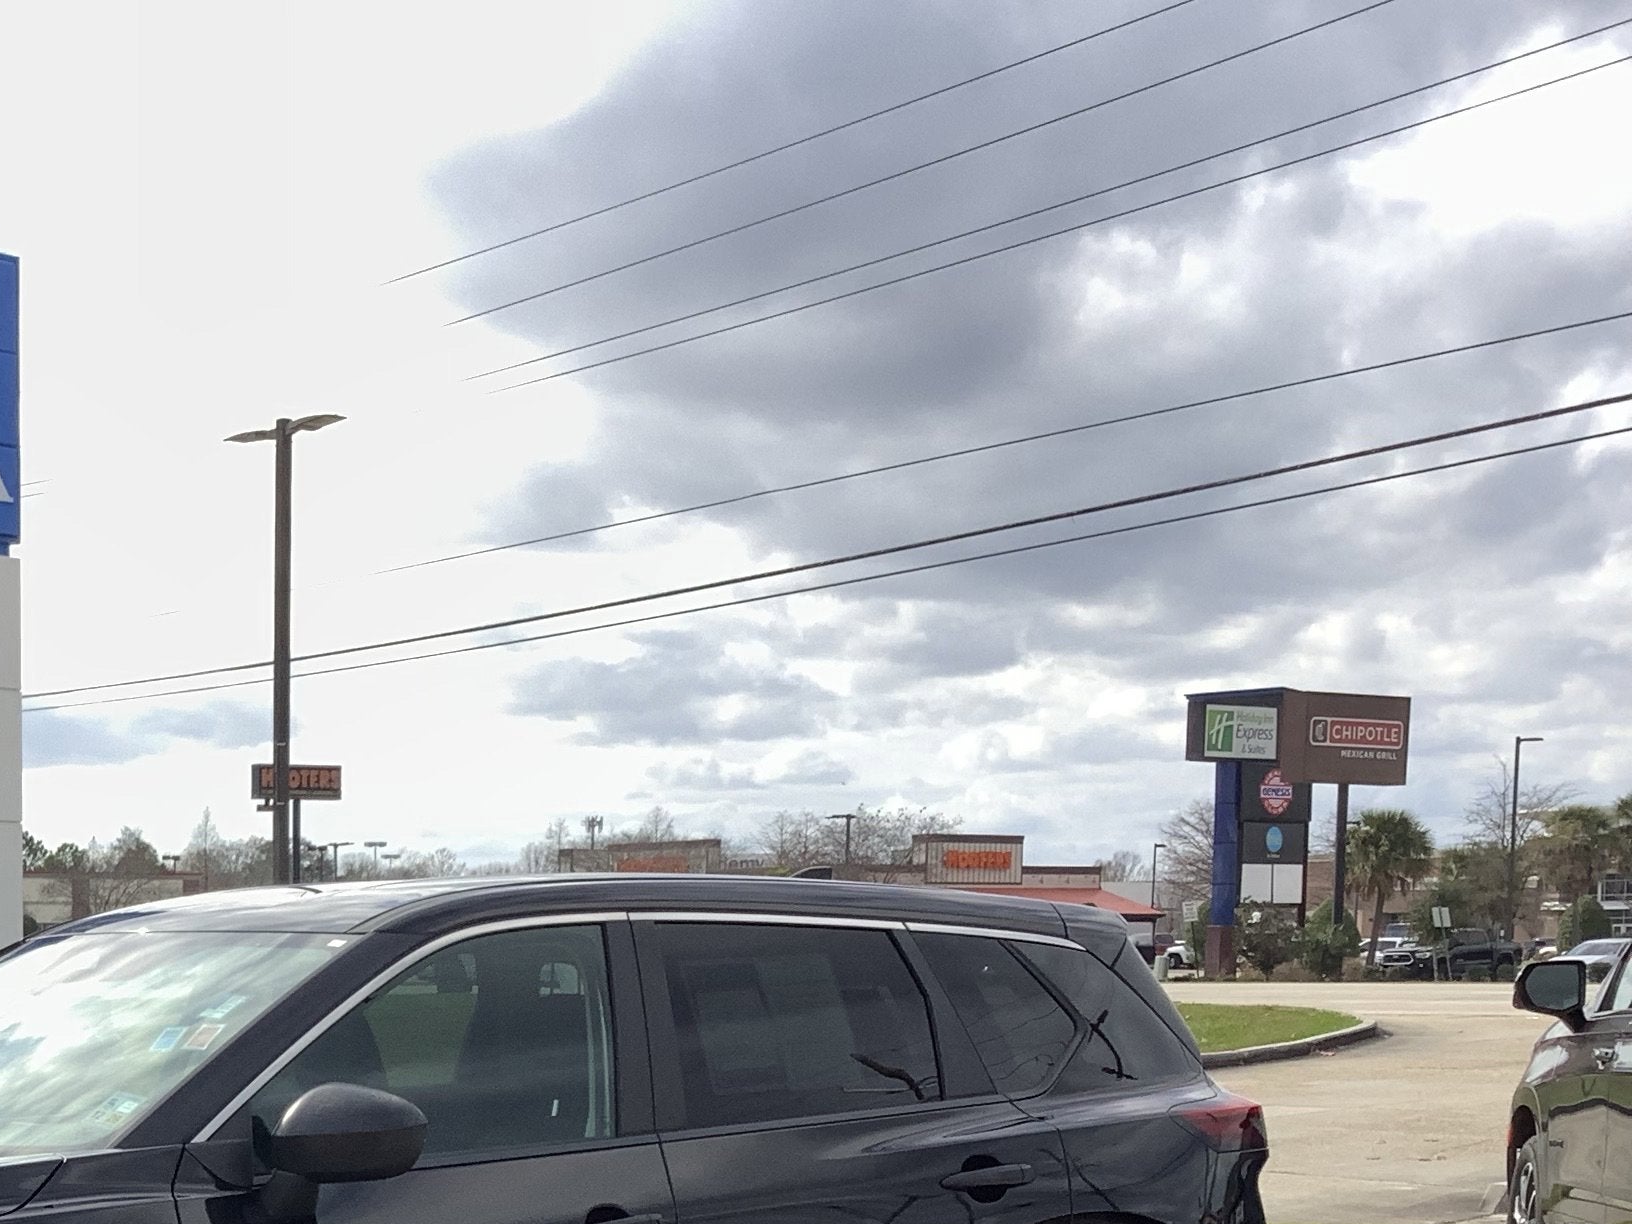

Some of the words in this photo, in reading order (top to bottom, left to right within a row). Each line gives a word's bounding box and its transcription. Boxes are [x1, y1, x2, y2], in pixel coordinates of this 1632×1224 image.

[1236, 723, 1273, 743] Express
[1332, 725, 1399, 742] CHIPOTLE
[1341, 750, 1374, 759] MEXICAN
[1376, 752, 1397, 760] GRILL
[261, 768, 337, 789] HOTERS
